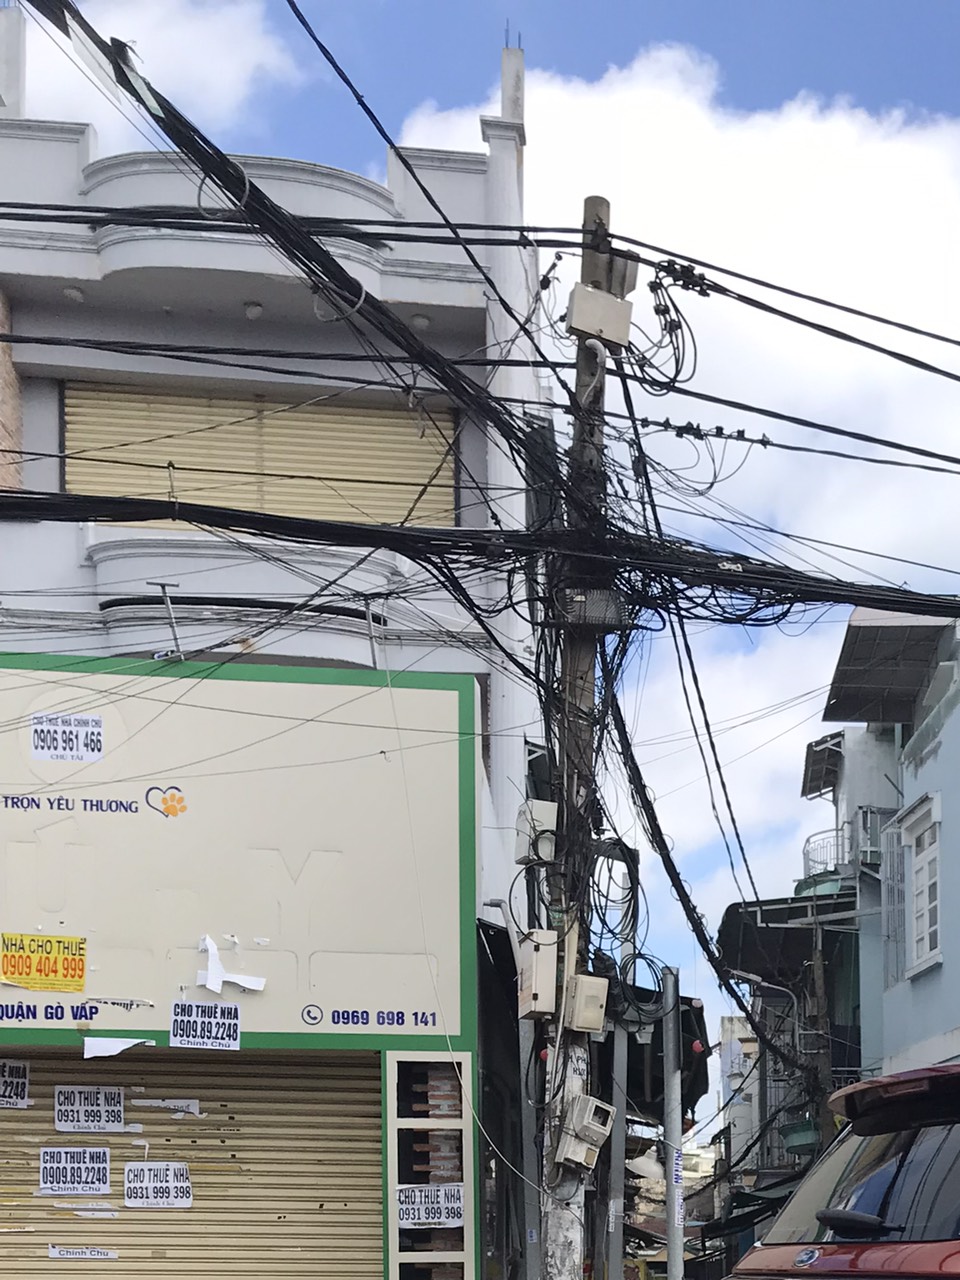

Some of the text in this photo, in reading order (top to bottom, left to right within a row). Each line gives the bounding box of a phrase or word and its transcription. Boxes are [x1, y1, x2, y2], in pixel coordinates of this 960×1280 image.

[33, 728, 102, 753] 0906 961 466
[2, 795, 139, 813] TRỌN YÊU THƯƠNG
[1, 932, 25, 953] NHÀ
[28, 938, 53, 956] CHO
[2, 953, 85, 980] 0909 404 999
[44, 1002, 64, 1020] GÒ
[70, 1001, 99, 1020] VẤP
[174, 1003, 239, 1020] CHO THUÊ NHÀ
[331, 1009, 436, 1026] 0969 698 141
[172, 1018, 239, 1042] 0909.89.2248
[179, 1039, 231, 1049] Chính Chủ
[8, 1063, 27, 1080] NHÀ
[57, 1087, 121, 1108] CHO THUÊ NHÀ
[57, 1109, 122, 1124] 0931 999 398
[42, 1149, 108, 1165] CHO THUÊ NHÀ
[42, 1166, 108, 1186] 0909.89.2248
[127, 1163, 191, 1184] CHO THUÊ NHÀ
[50, 1185, 79, 1193] Chính
[126, 1186, 191, 1200] 0931 999 398
[398, 1184, 462, 1206] CHO THUÊ NHÀ
[398, 1206, 462, 1222] 0931 999 398
[58, 1249, 87, 1257] Chính
